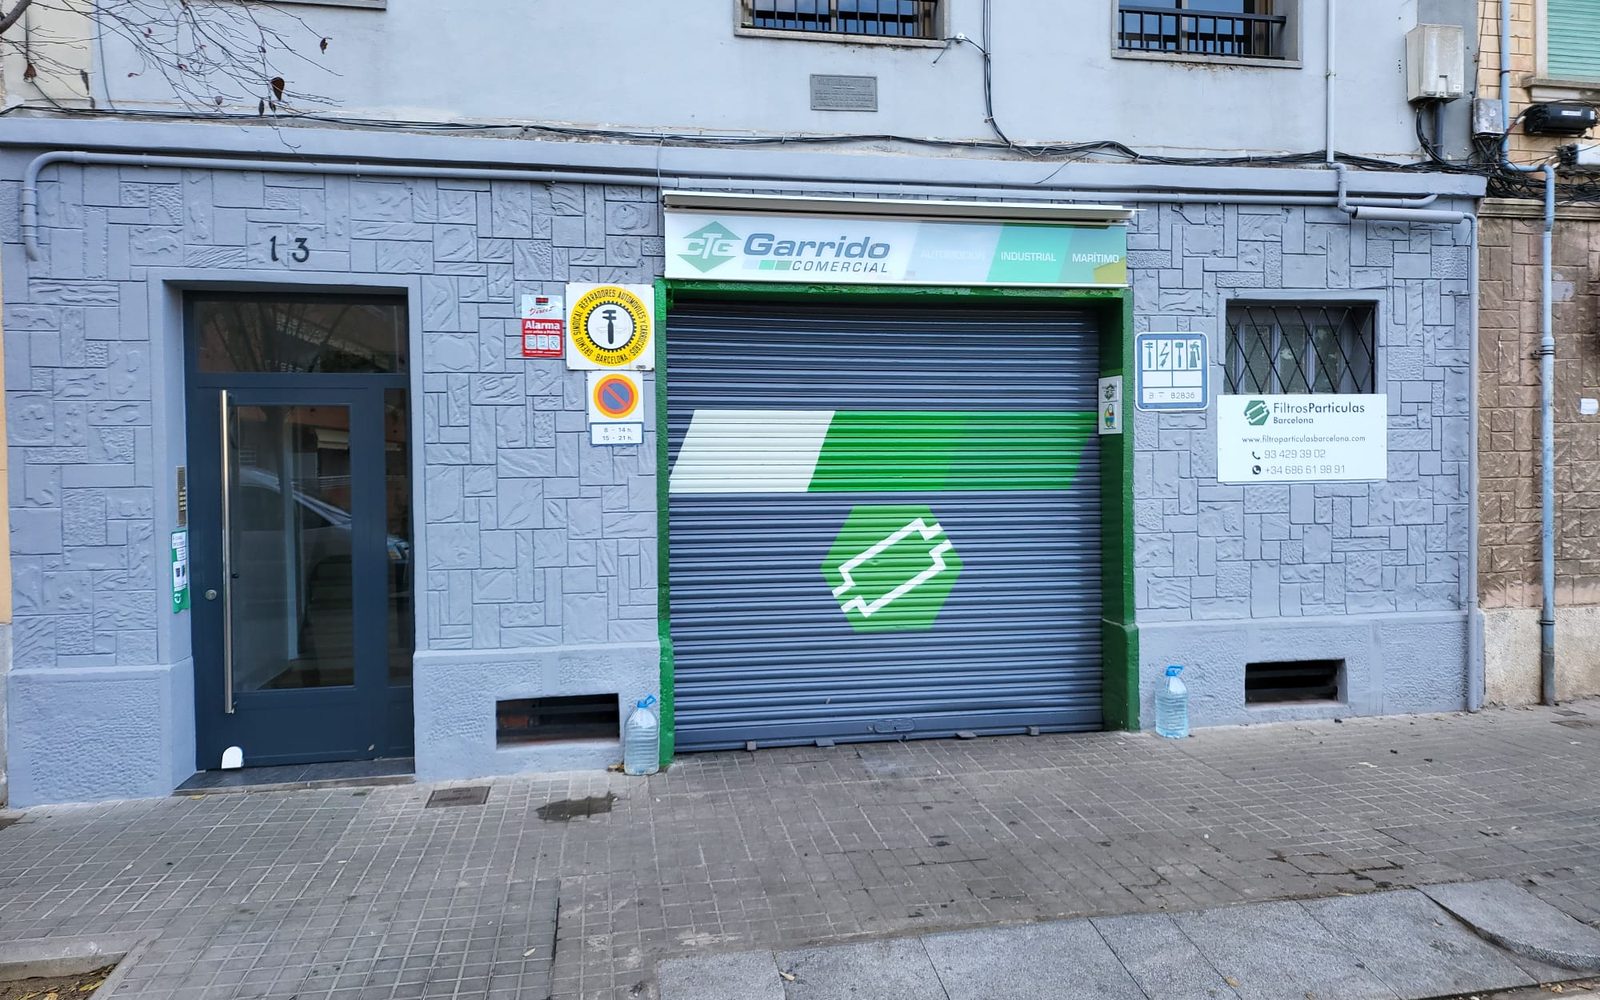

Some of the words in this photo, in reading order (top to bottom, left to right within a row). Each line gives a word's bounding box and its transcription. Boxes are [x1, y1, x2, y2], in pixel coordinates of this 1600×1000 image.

[270, 235, 310, 263] 13
[743, 233, 891, 259] Garrido
[1001, 252, 1056, 262] INDUSTRIAL
[1072, 252, 1120, 263] MARÍTIMO
[792, 260, 888, 273] COMERCIAL
[578, 289, 616, 310] REPARADORES
[617, 291, 646, 319] AUTOMOVILES
[525, 320, 560, 330] Alarma
[572, 310, 583, 336] SINDICAL
[575, 336, 594, 357] GREMIO
[630, 324, 648, 356] CARROCEROS
[595, 353, 628, 364] BARCELONA
[1273, 401, 1365, 414] FiltrosParticulas
[1273, 415, 1314, 424] Barcelona
[1241, 433, 1366, 444] www.filtroparticulasbarcelona.com
[1264, 449, 1277, 459] 93
[1279, 449, 1298, 459] 429
[1299, 449, 1312, 459] 39
[1313, 449, 1326, 459] 02
[1266, 465, 1283, 475] +34
[1334, 464, 1345, 474] 91
